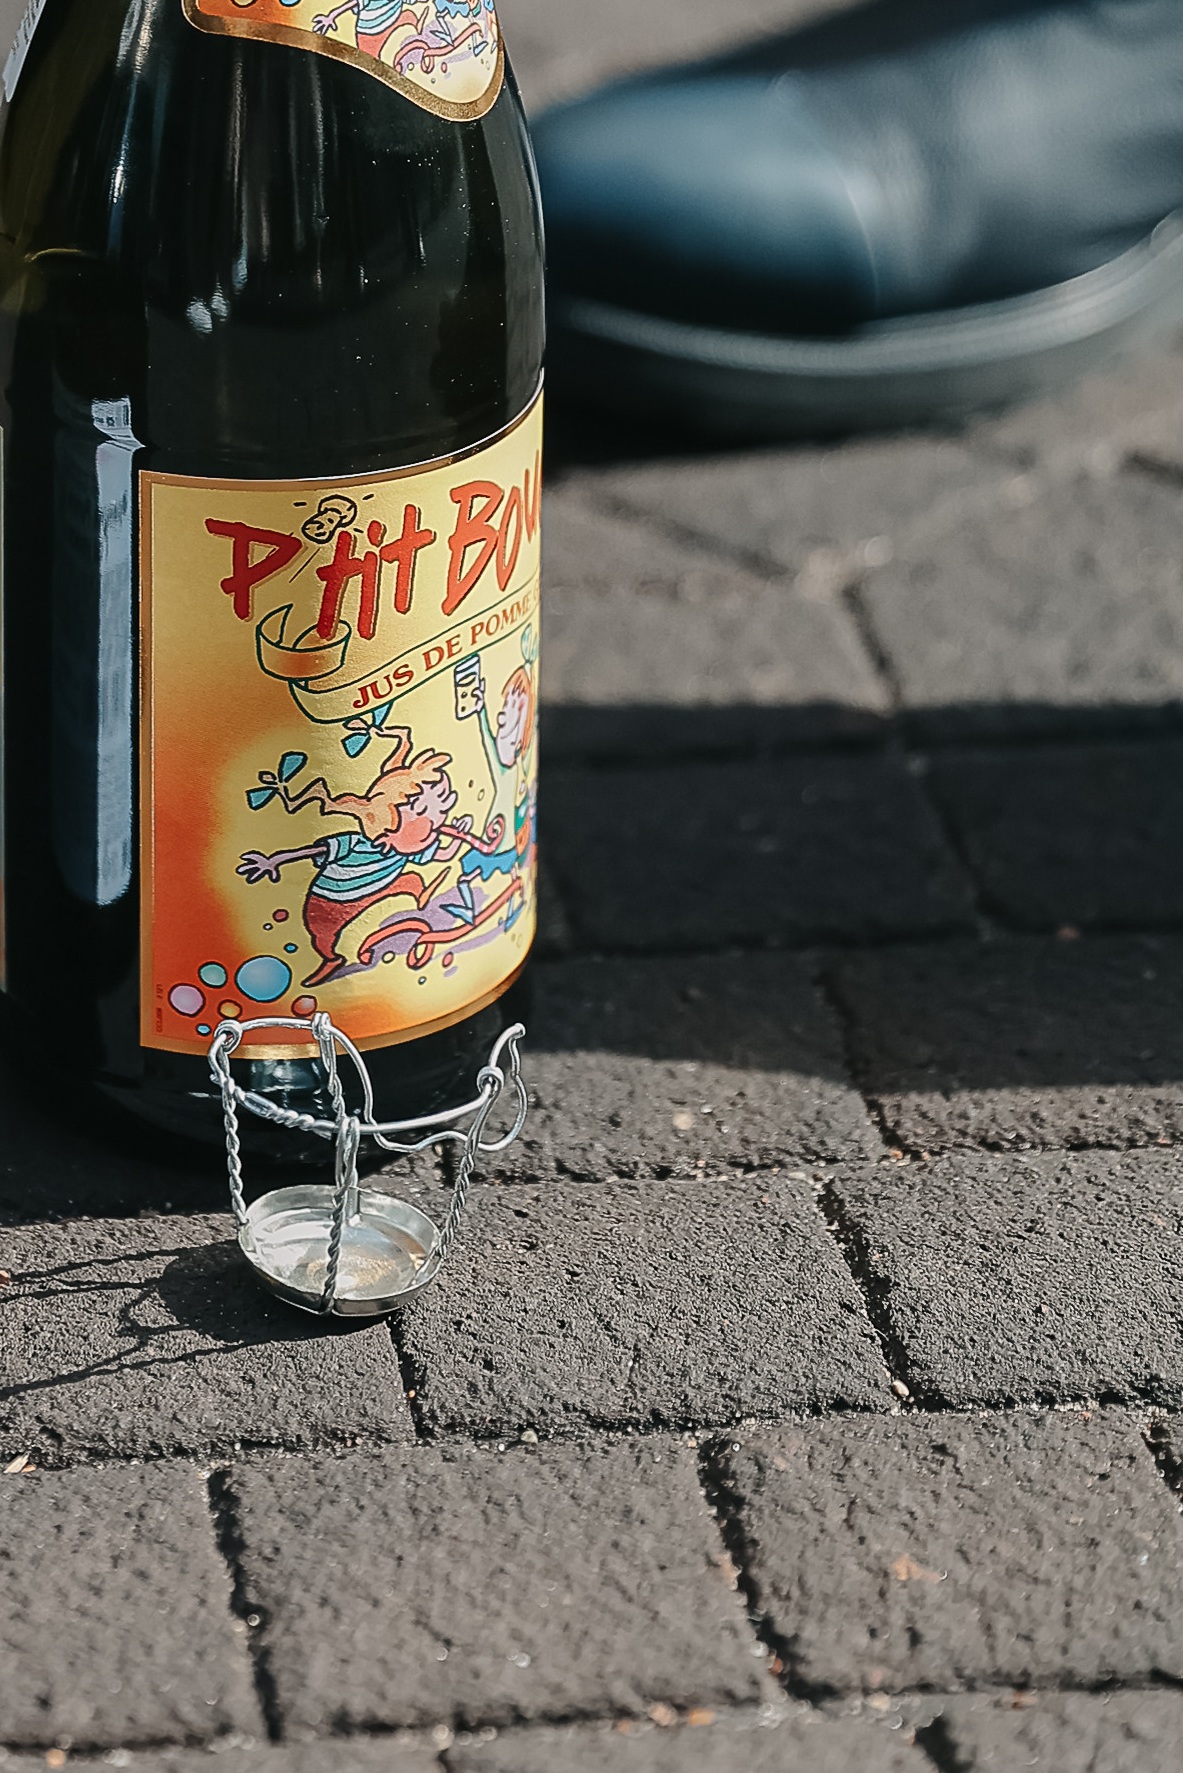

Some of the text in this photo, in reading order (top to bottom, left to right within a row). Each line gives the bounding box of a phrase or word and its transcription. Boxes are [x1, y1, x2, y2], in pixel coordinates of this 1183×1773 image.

[442, 449, 540, 616] BOU
[353, 598, 531, 709] JUS DE POMME
